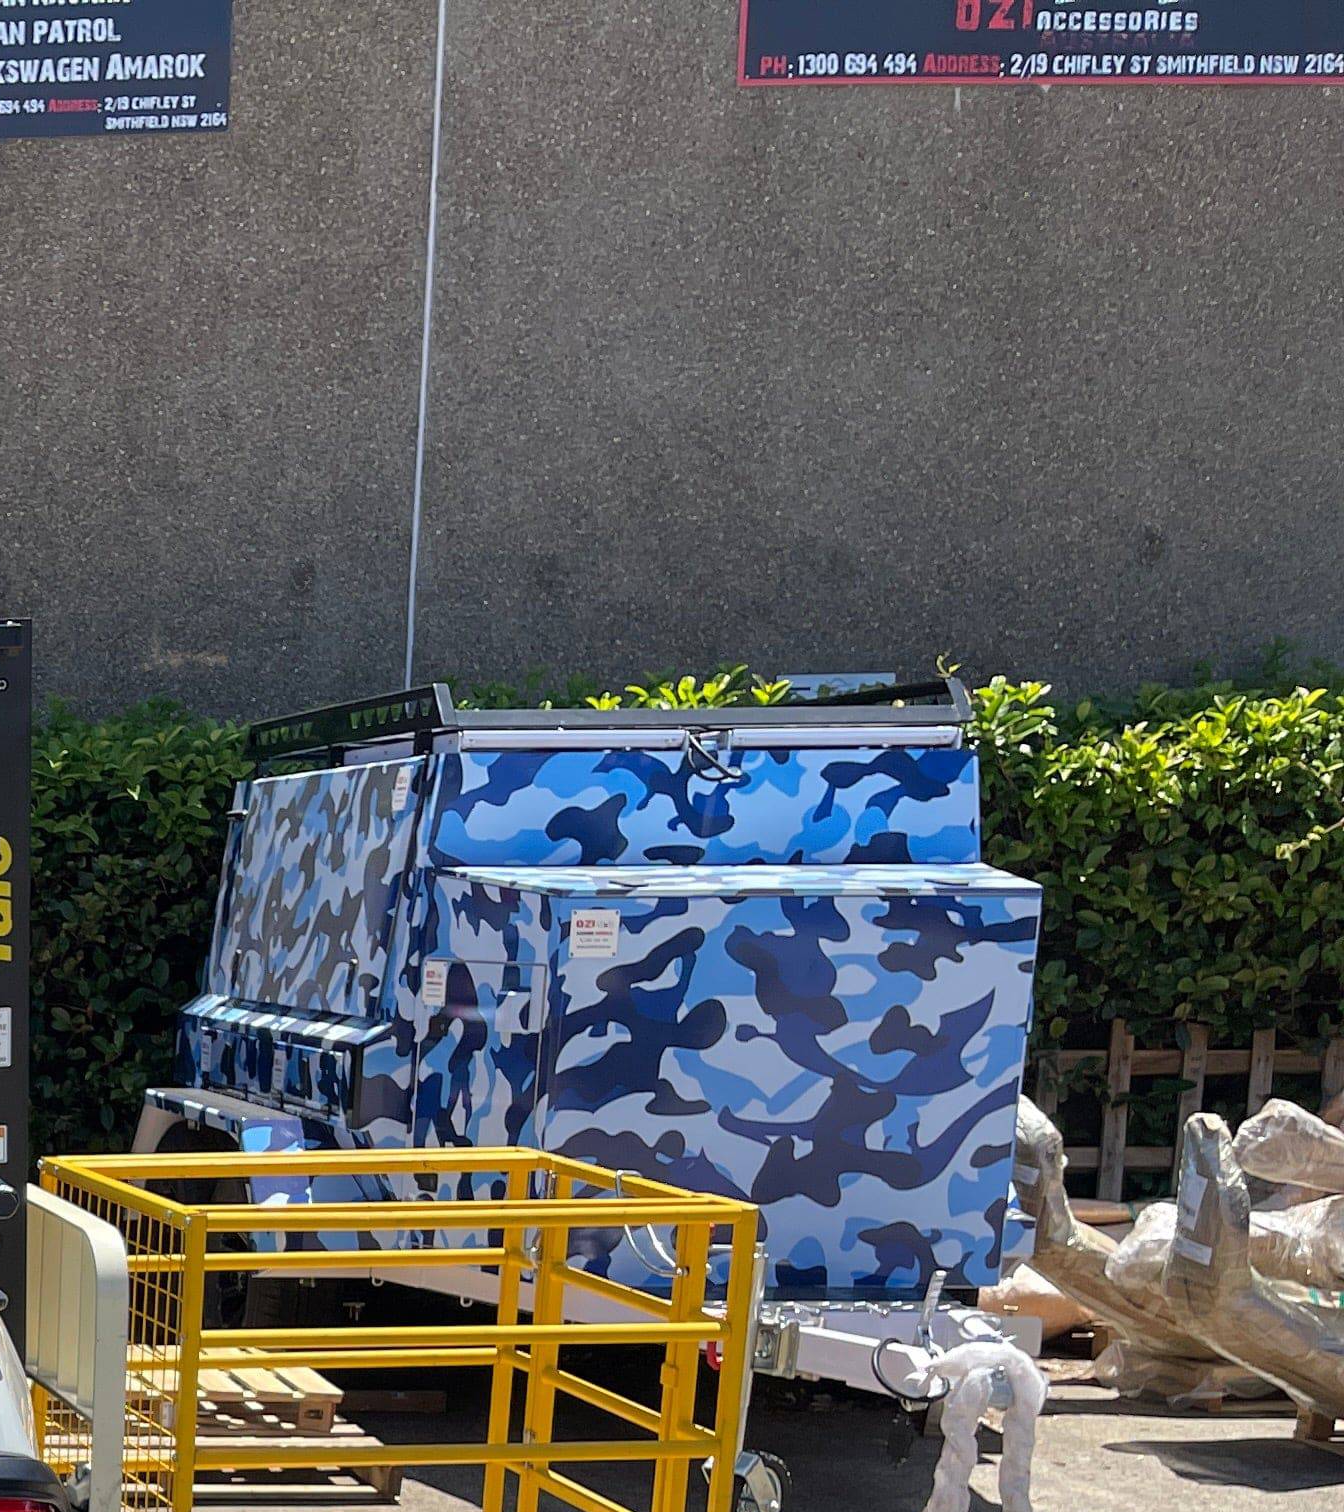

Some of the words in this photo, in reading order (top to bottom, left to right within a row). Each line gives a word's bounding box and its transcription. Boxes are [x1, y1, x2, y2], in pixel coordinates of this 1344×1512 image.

[33, 18, 122, 44] PATROL
[1036, 10, 1199, 32] ACCESSORIES
[106, 53, 207, 80] AMAROK
[798, 54, 839, 75] 1300
[844, 53, 878, 75] 694
[883, 53, 918, 75] 494
[922, 52, 1005, 76] ADDRESS:
[1010, 53, 1047, 79] 2/19
[1052, 54, 1122, 75] CHIFLEY
[1130, 54, 1151, 75] ST
[1156, 54, 1255, 75] SMITHFIELD
[1260, 53, 1300, 75] NSW
[1304, 53, 1344, 74] 2164
[131, 96, 179, 110] CHIFLEY
[182, 95, 196, 108] ST
[105, 115, 169, 130] SMITHFIELD
[171, 114, 197, 128] NSW
[200, 112, 227, 127] 2164
